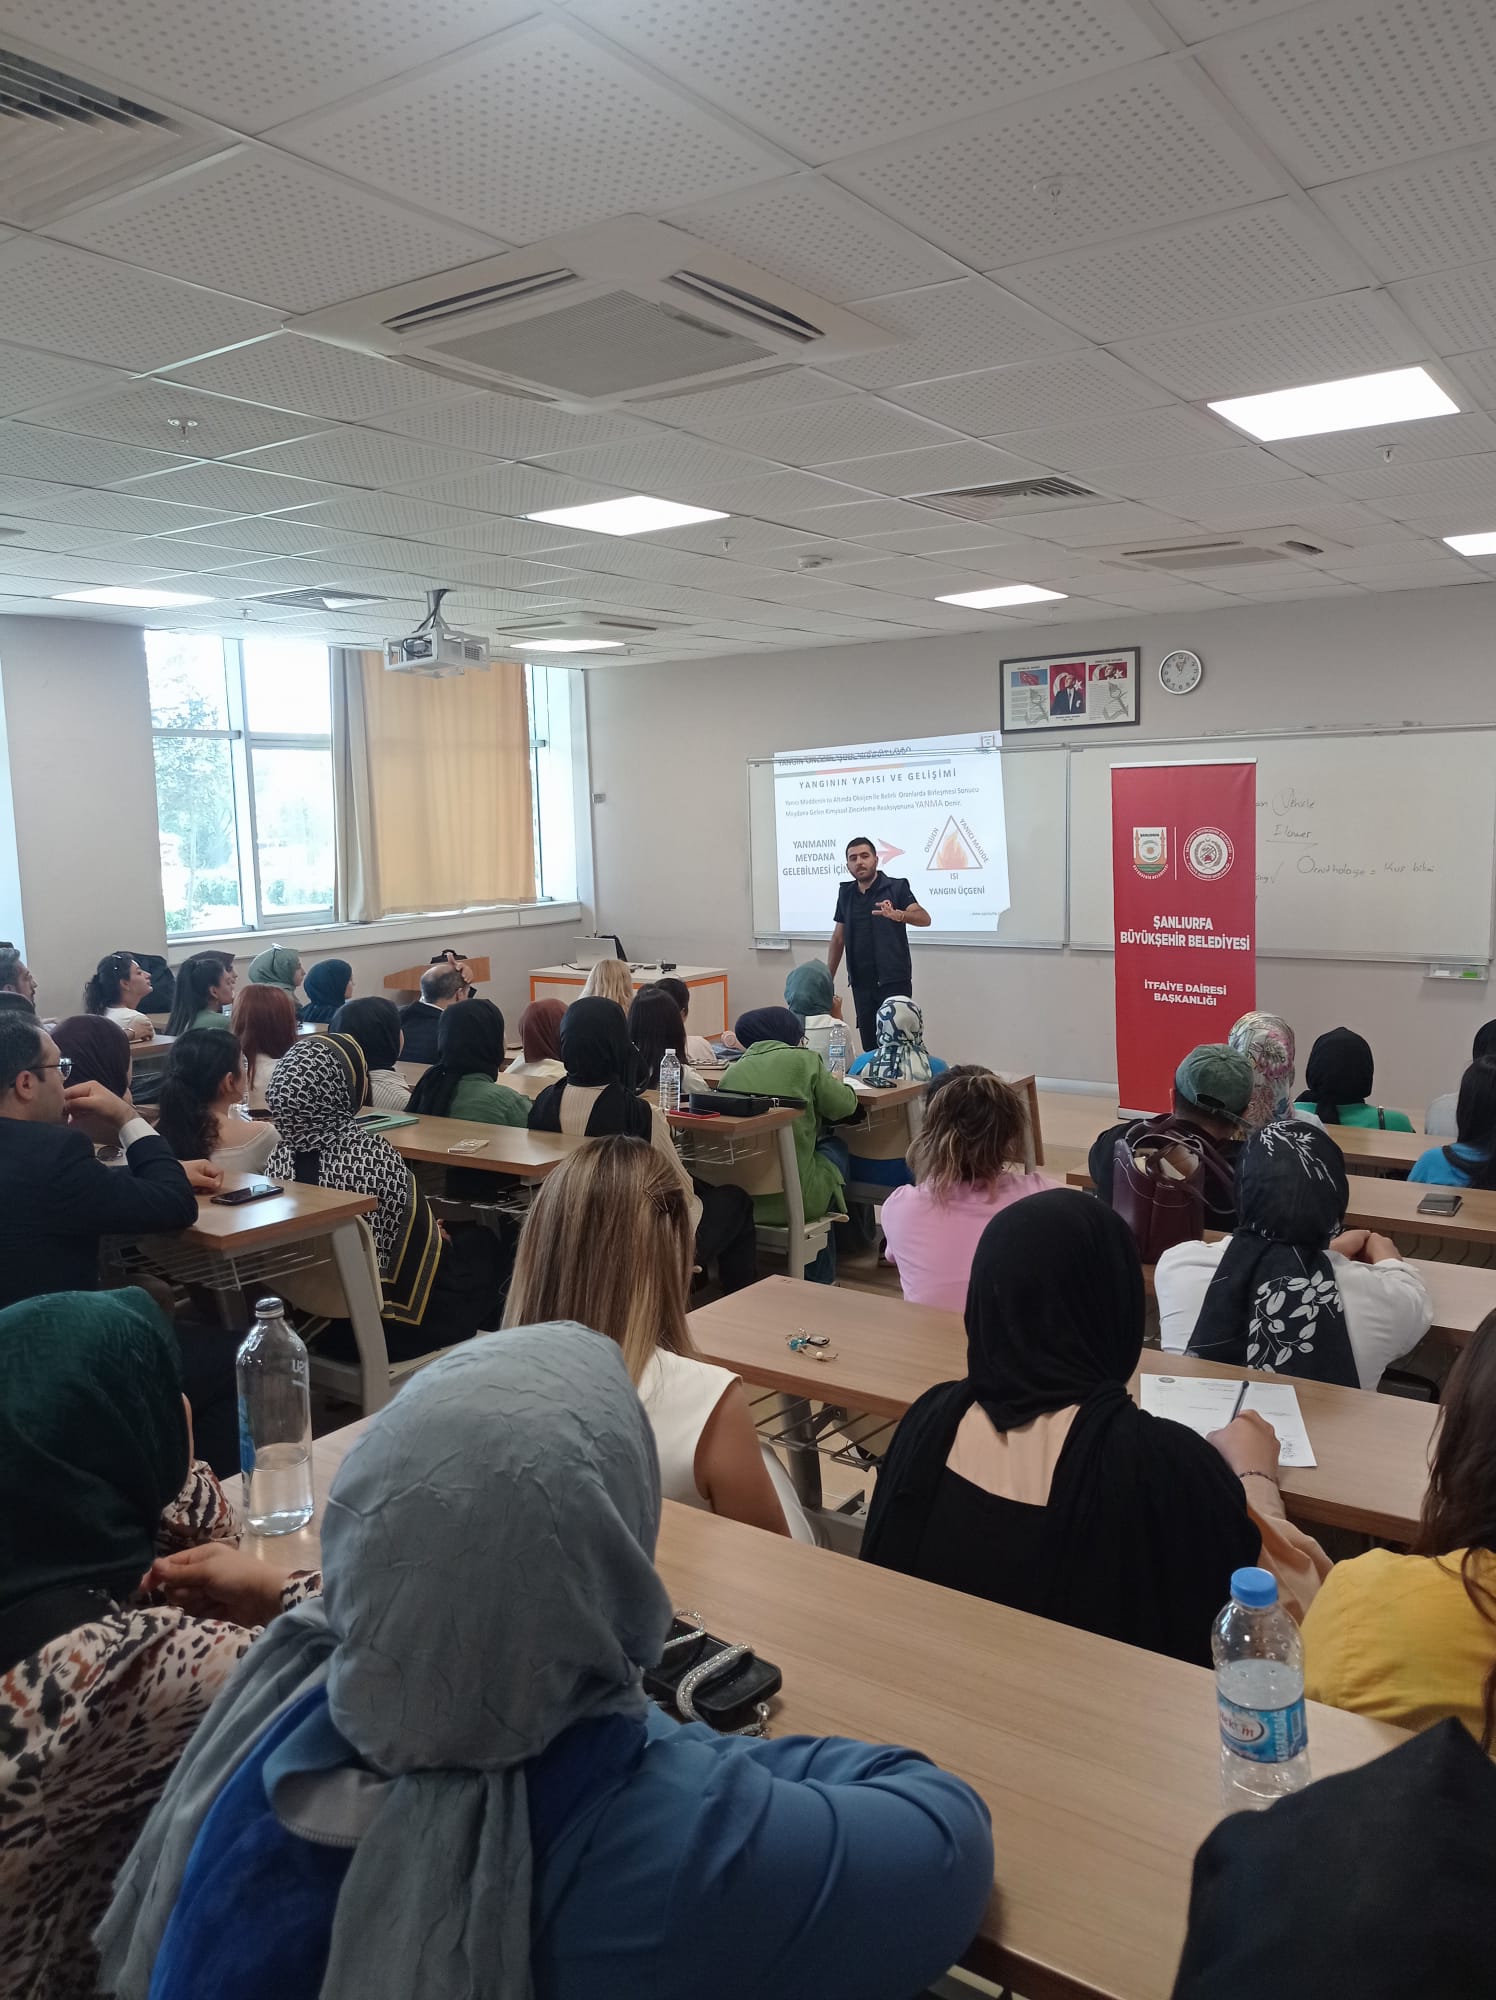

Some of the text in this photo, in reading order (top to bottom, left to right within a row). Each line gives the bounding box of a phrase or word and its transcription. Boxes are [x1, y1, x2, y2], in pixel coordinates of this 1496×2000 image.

[799, 767, 957, 789] YANGININ YAPISI VE GELİŞİMİ
[915, 799, 944, 809] YANMA
[792, 839, 837, 849] YANMANIN
[795, 852, 836, 862] MEYDANA
[782, 864, 831, 876] GELEBİLMESİ
[928, 885, 985, 896] YANGIN ÜÇGENİ
[1153, 915, 1214, 930] ŞANLIURFA
[1120, 928, 1251, 951] BÜYÜKŞEHİR BELEDİYESİ
[1144, 978, 1227, 995] İTFAİYE DAİRESİ
[1153, 992, 1217, 1006] BAŞKANLIĞI
